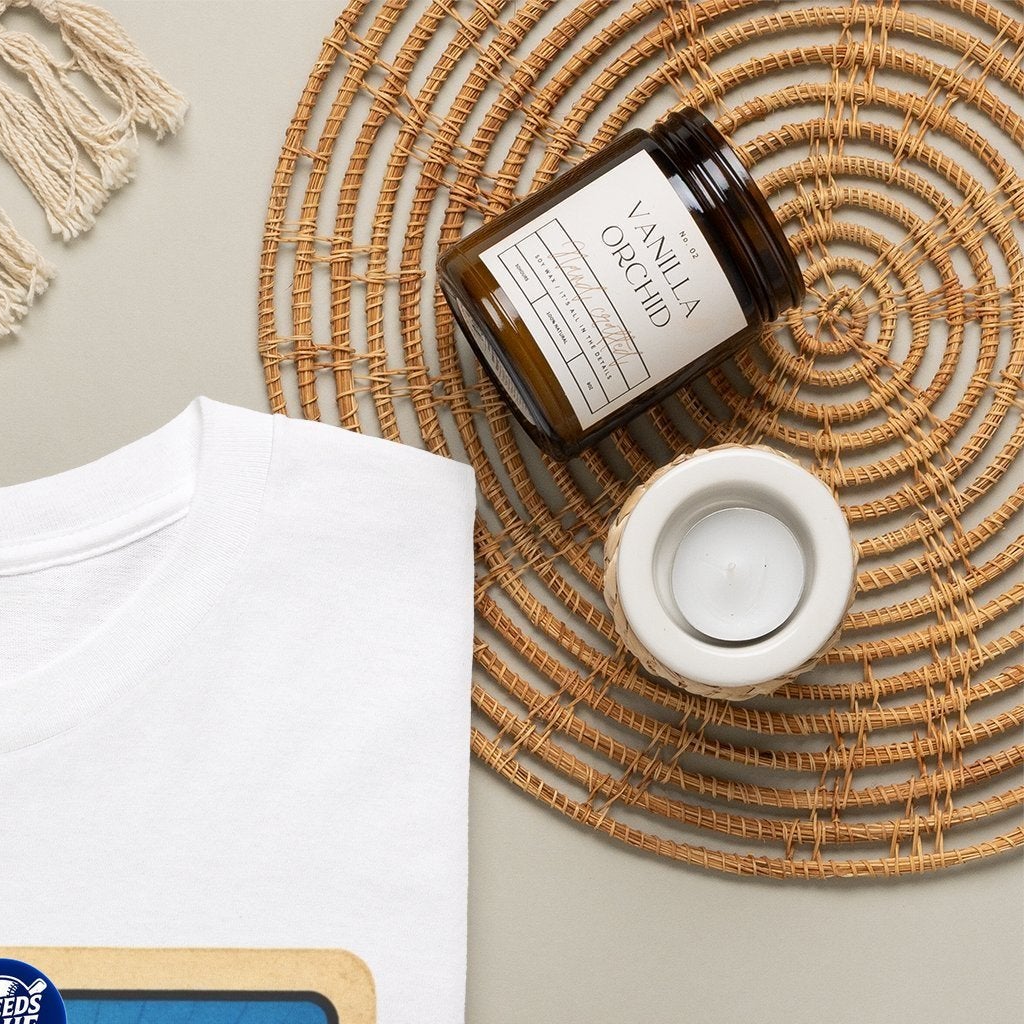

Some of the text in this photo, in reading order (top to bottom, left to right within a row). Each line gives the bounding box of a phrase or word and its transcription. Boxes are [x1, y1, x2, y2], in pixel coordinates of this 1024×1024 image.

[547, 240, 607, 301] Hand
[601, 225, 671, 328] ORCHID
[627, 200, 701, 318] VANILLA
[678, 230, 699, 259] No. 02
[535, 254, 545, 267] SOY
[544, 269, 556, 283] WAX
[559, 291, 571, 306] IT'S
[570, 308, 580, 322] ALL
[579, 324, 586, 334] IN
[586, 335, 596, 349] THE
[594, 351, 613, 380] DETAILS
